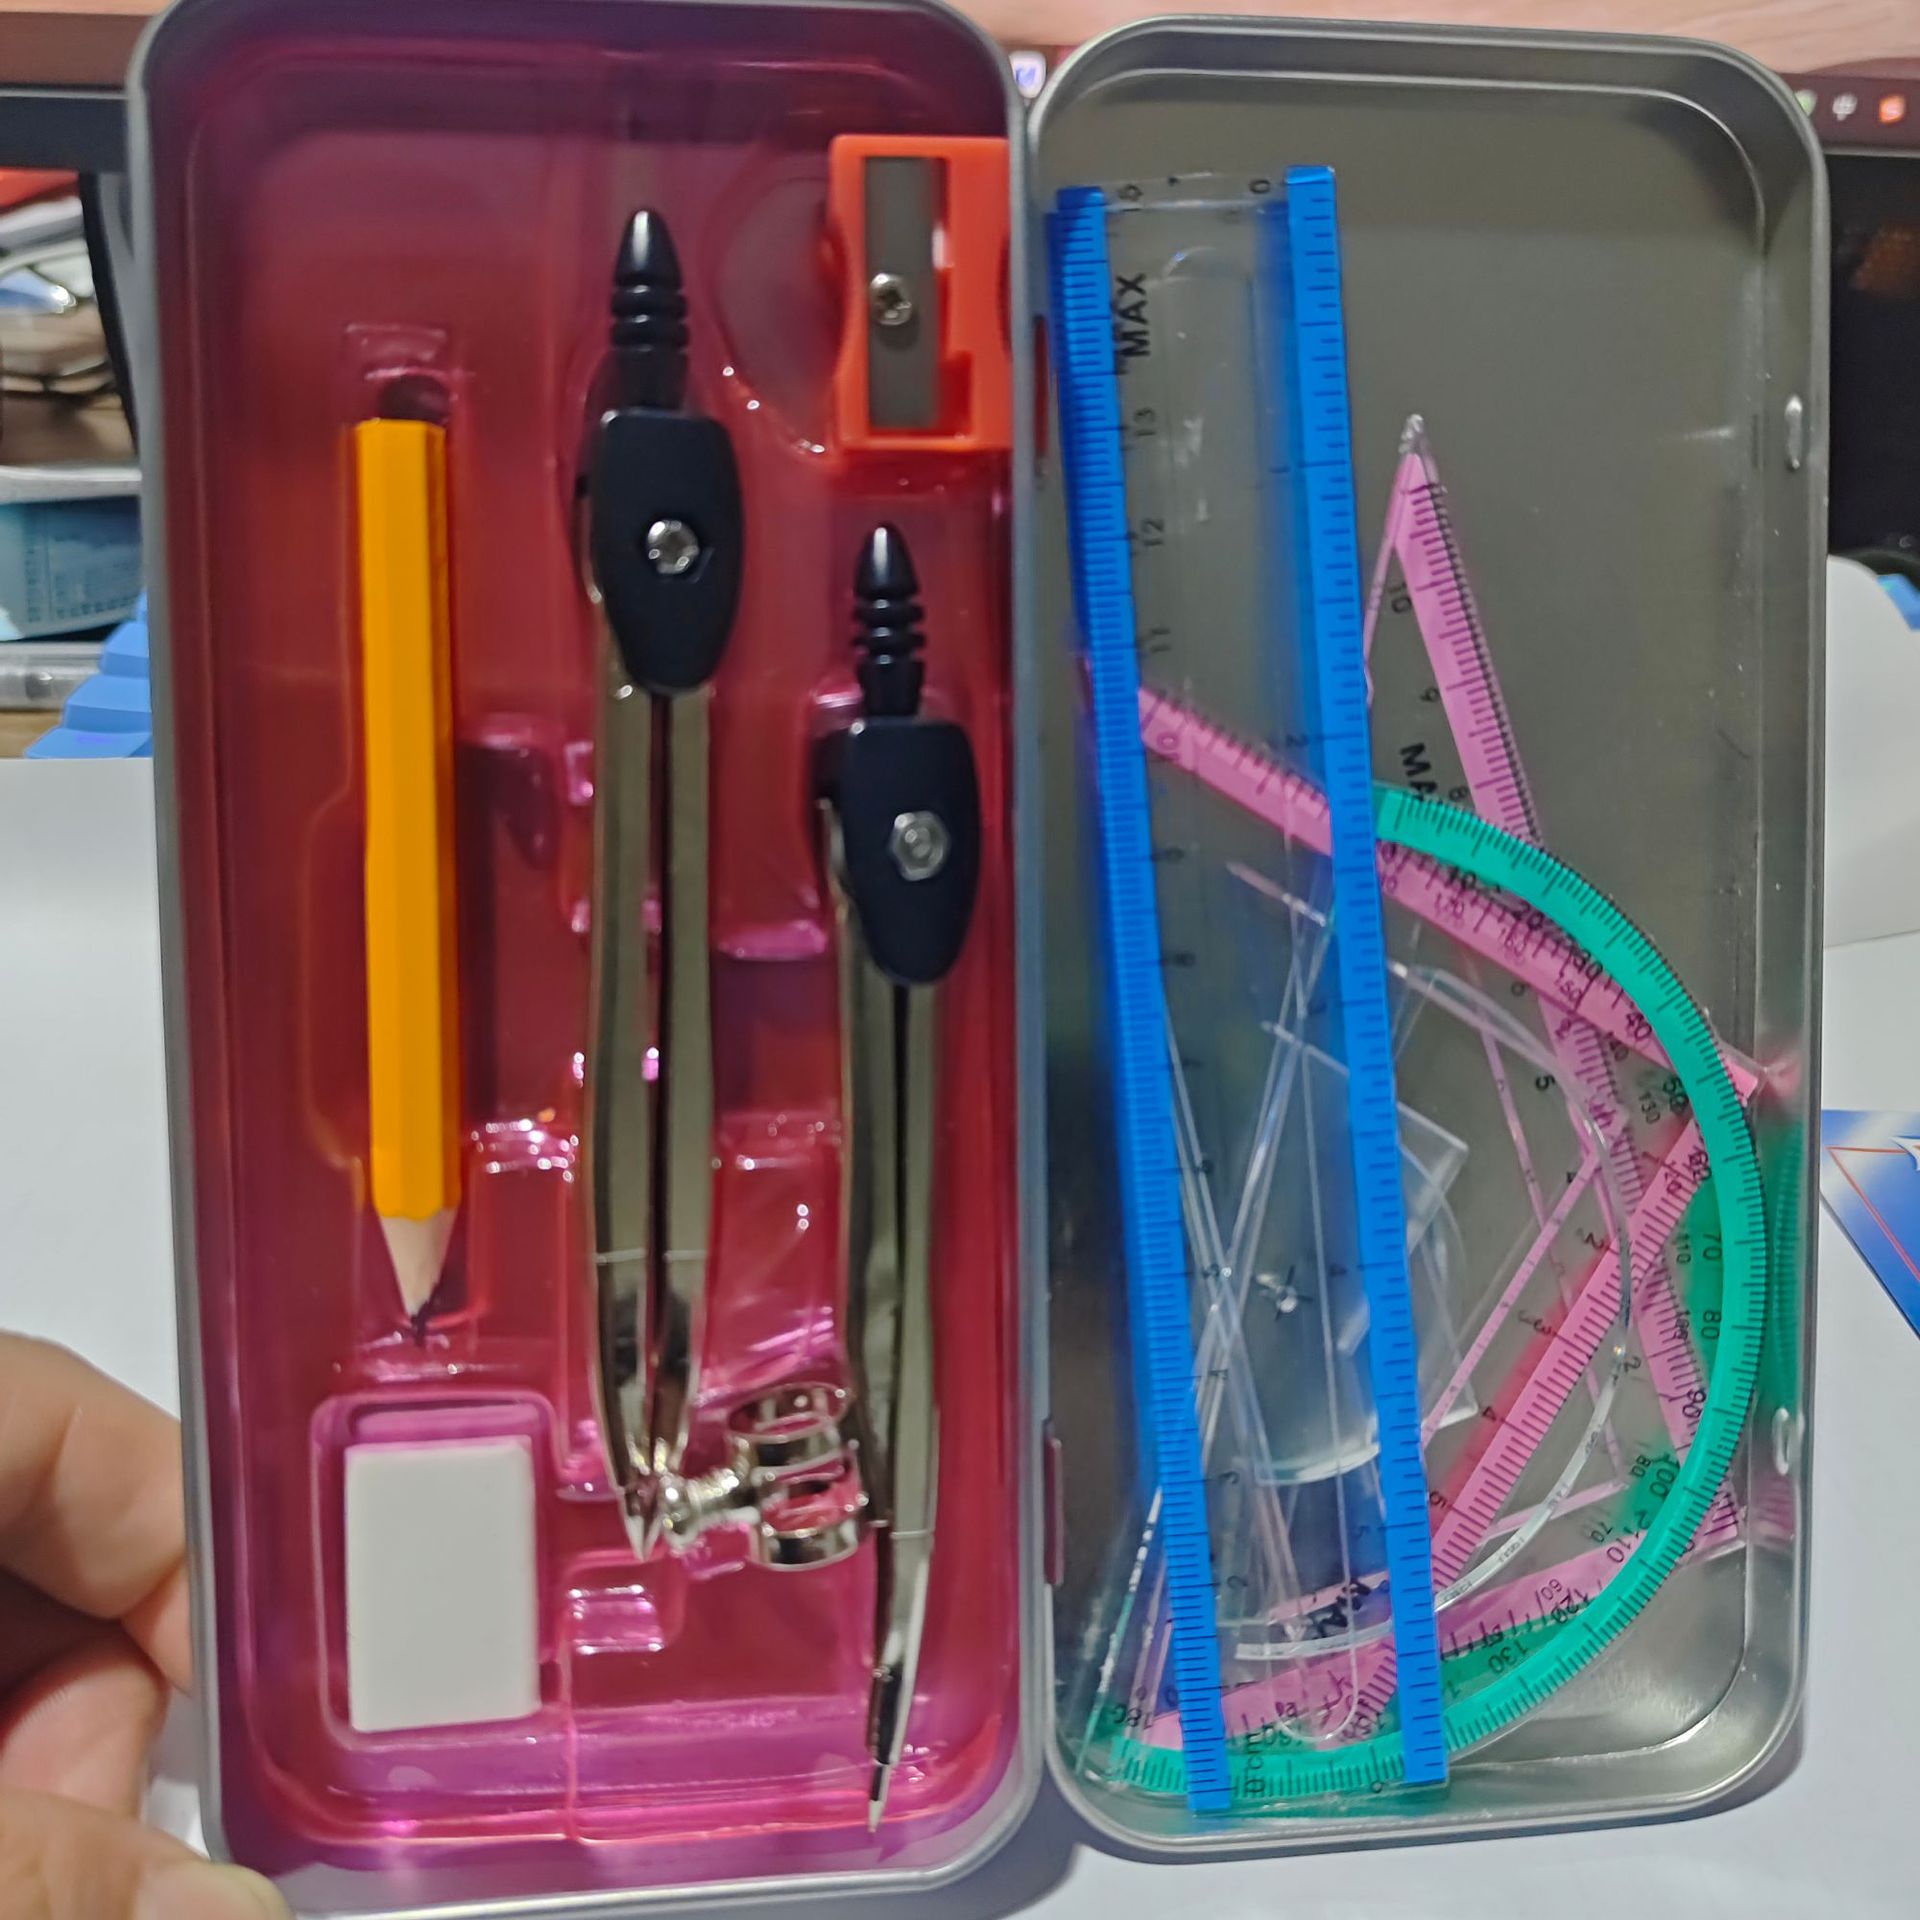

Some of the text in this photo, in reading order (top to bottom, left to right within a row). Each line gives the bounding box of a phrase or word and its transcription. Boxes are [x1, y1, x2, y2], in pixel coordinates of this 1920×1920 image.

[1115, 273, 1151, 358] MAX
[1133, 407, 1155, 437] 13
[1141, 518, 1164, 546] 12
[1388, 582, 1411, 614] 10
[1400, 742, 1438, 803] MA
[1639, 1093, 1660, 1124] 130
[1703, 1233, 1722, 1261] 70
[1701, 1310, 1721, 1340] 80
[1683, 1388, 1707, 1418] 90
[1631, 1454, 1652, 1477] 80
[1591, 1522, 1613, 1543] 70
[1541, 1579, 1563, 1600] 60
[1489, 1640, 1528, 1673] 130
